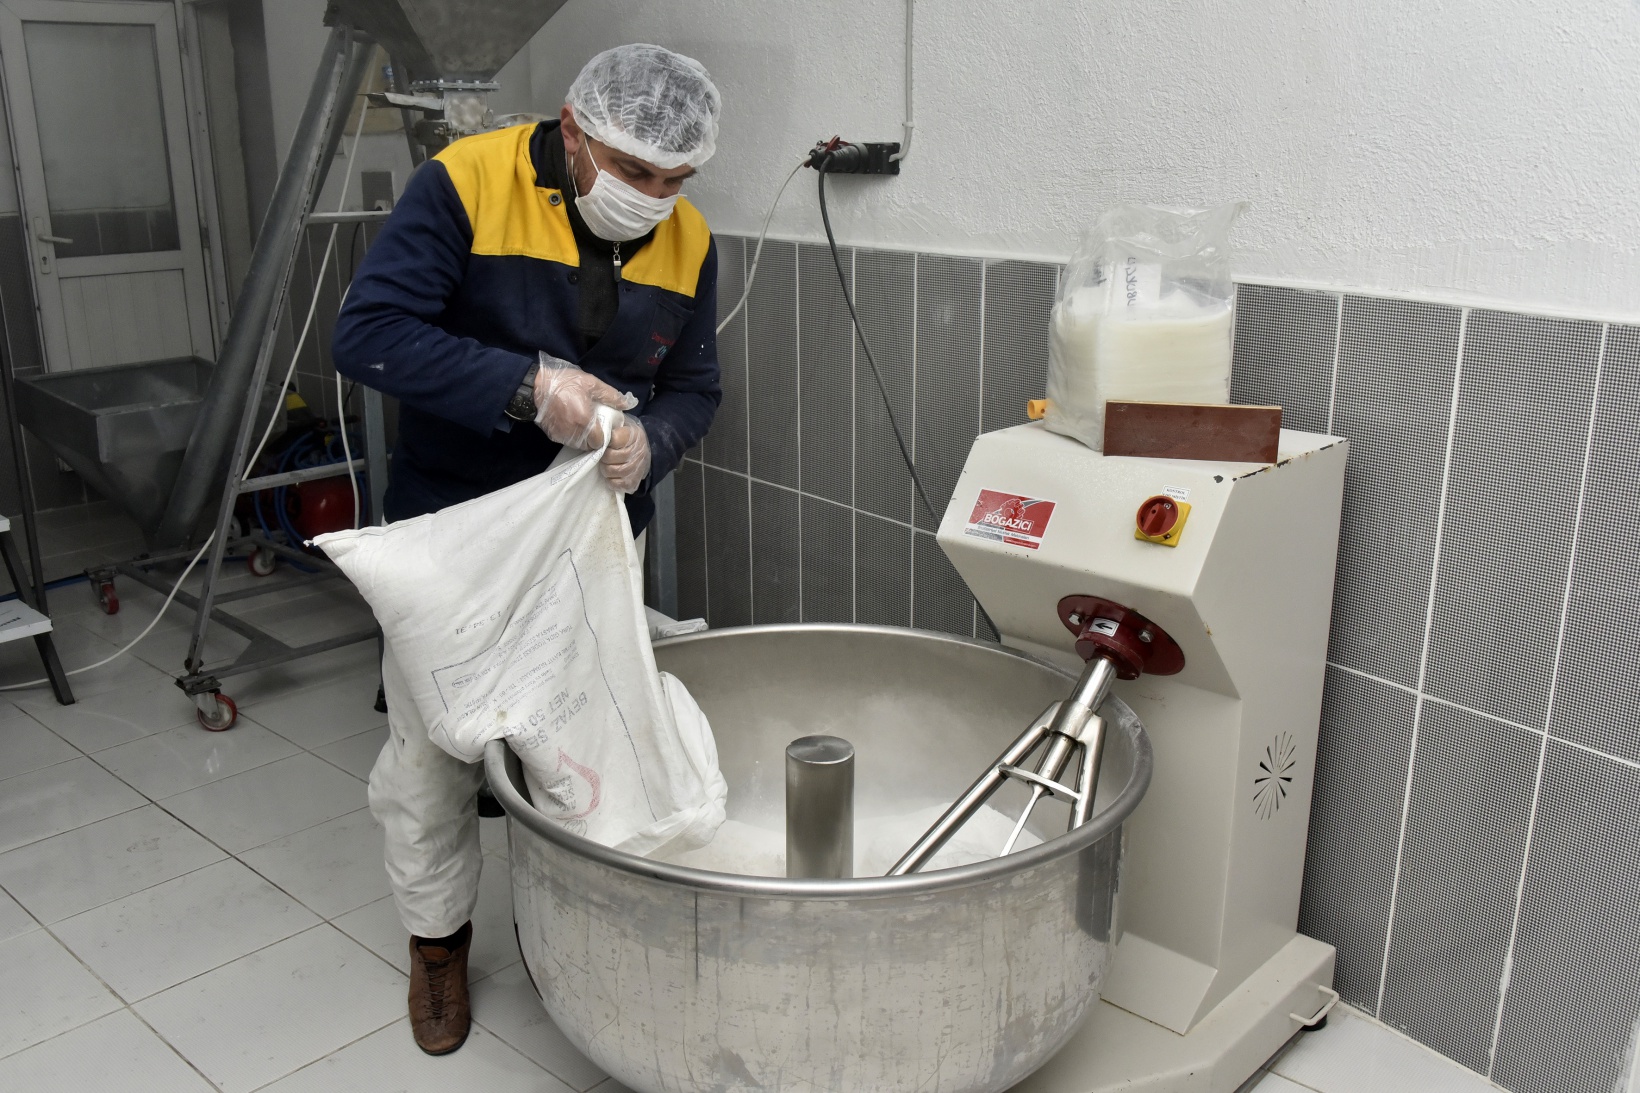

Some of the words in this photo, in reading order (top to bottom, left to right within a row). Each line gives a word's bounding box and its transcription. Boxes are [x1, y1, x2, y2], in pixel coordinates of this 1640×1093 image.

[548, 688, 570, 713] NET
[554, 691, 588, 733] BEYAZ
[528, 708, 546, 727] 50
